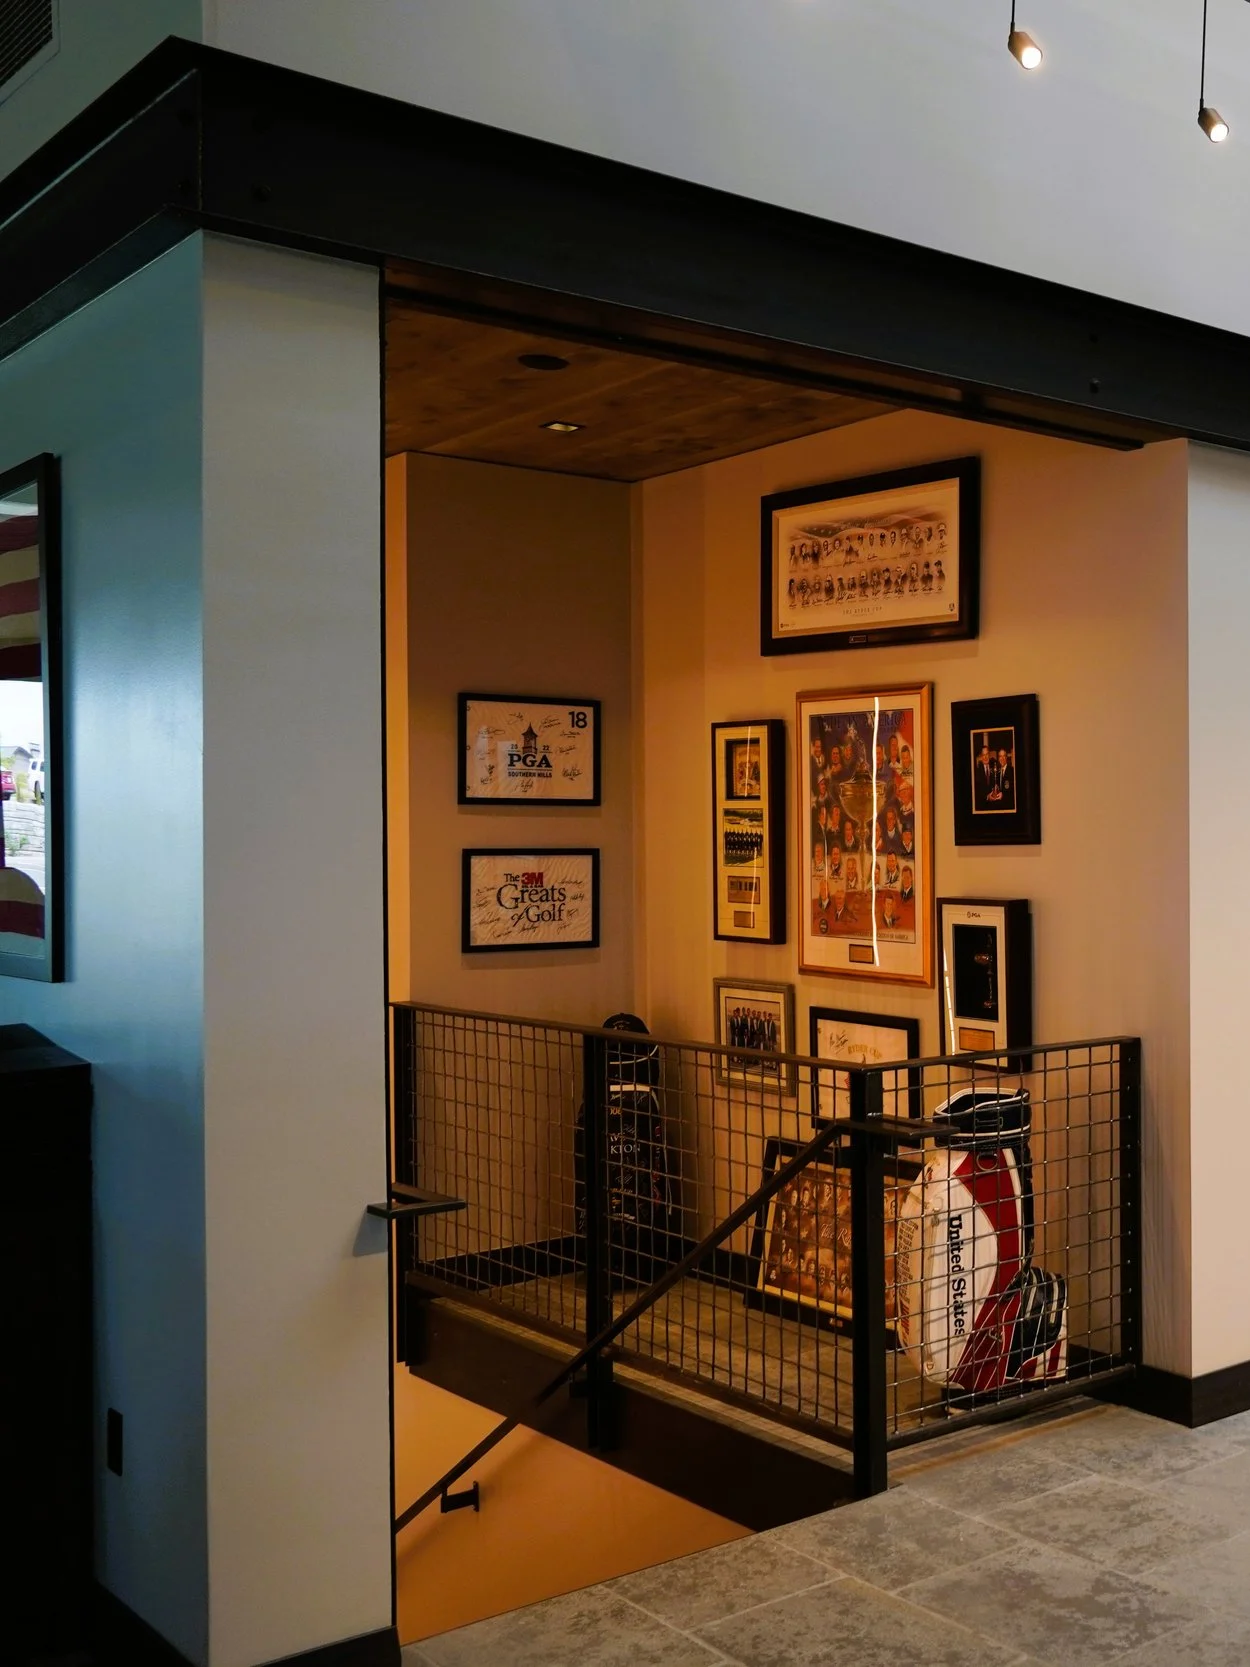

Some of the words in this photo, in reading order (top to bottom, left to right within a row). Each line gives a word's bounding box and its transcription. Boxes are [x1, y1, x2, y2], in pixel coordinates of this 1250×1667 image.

[568, 711, 587, 728] 18
[508, 753, 552, 768] PGA
[503, 873, 520, 882] The
[521, 872, 543, 887] 3M
[497, 884, 566, 909] Greats
[511, 904, 532, 927] of
[526, 903, 565, 922] Golf
[949, 1214, 964, 1273] United
[952, 1278, 967, 1336] States
